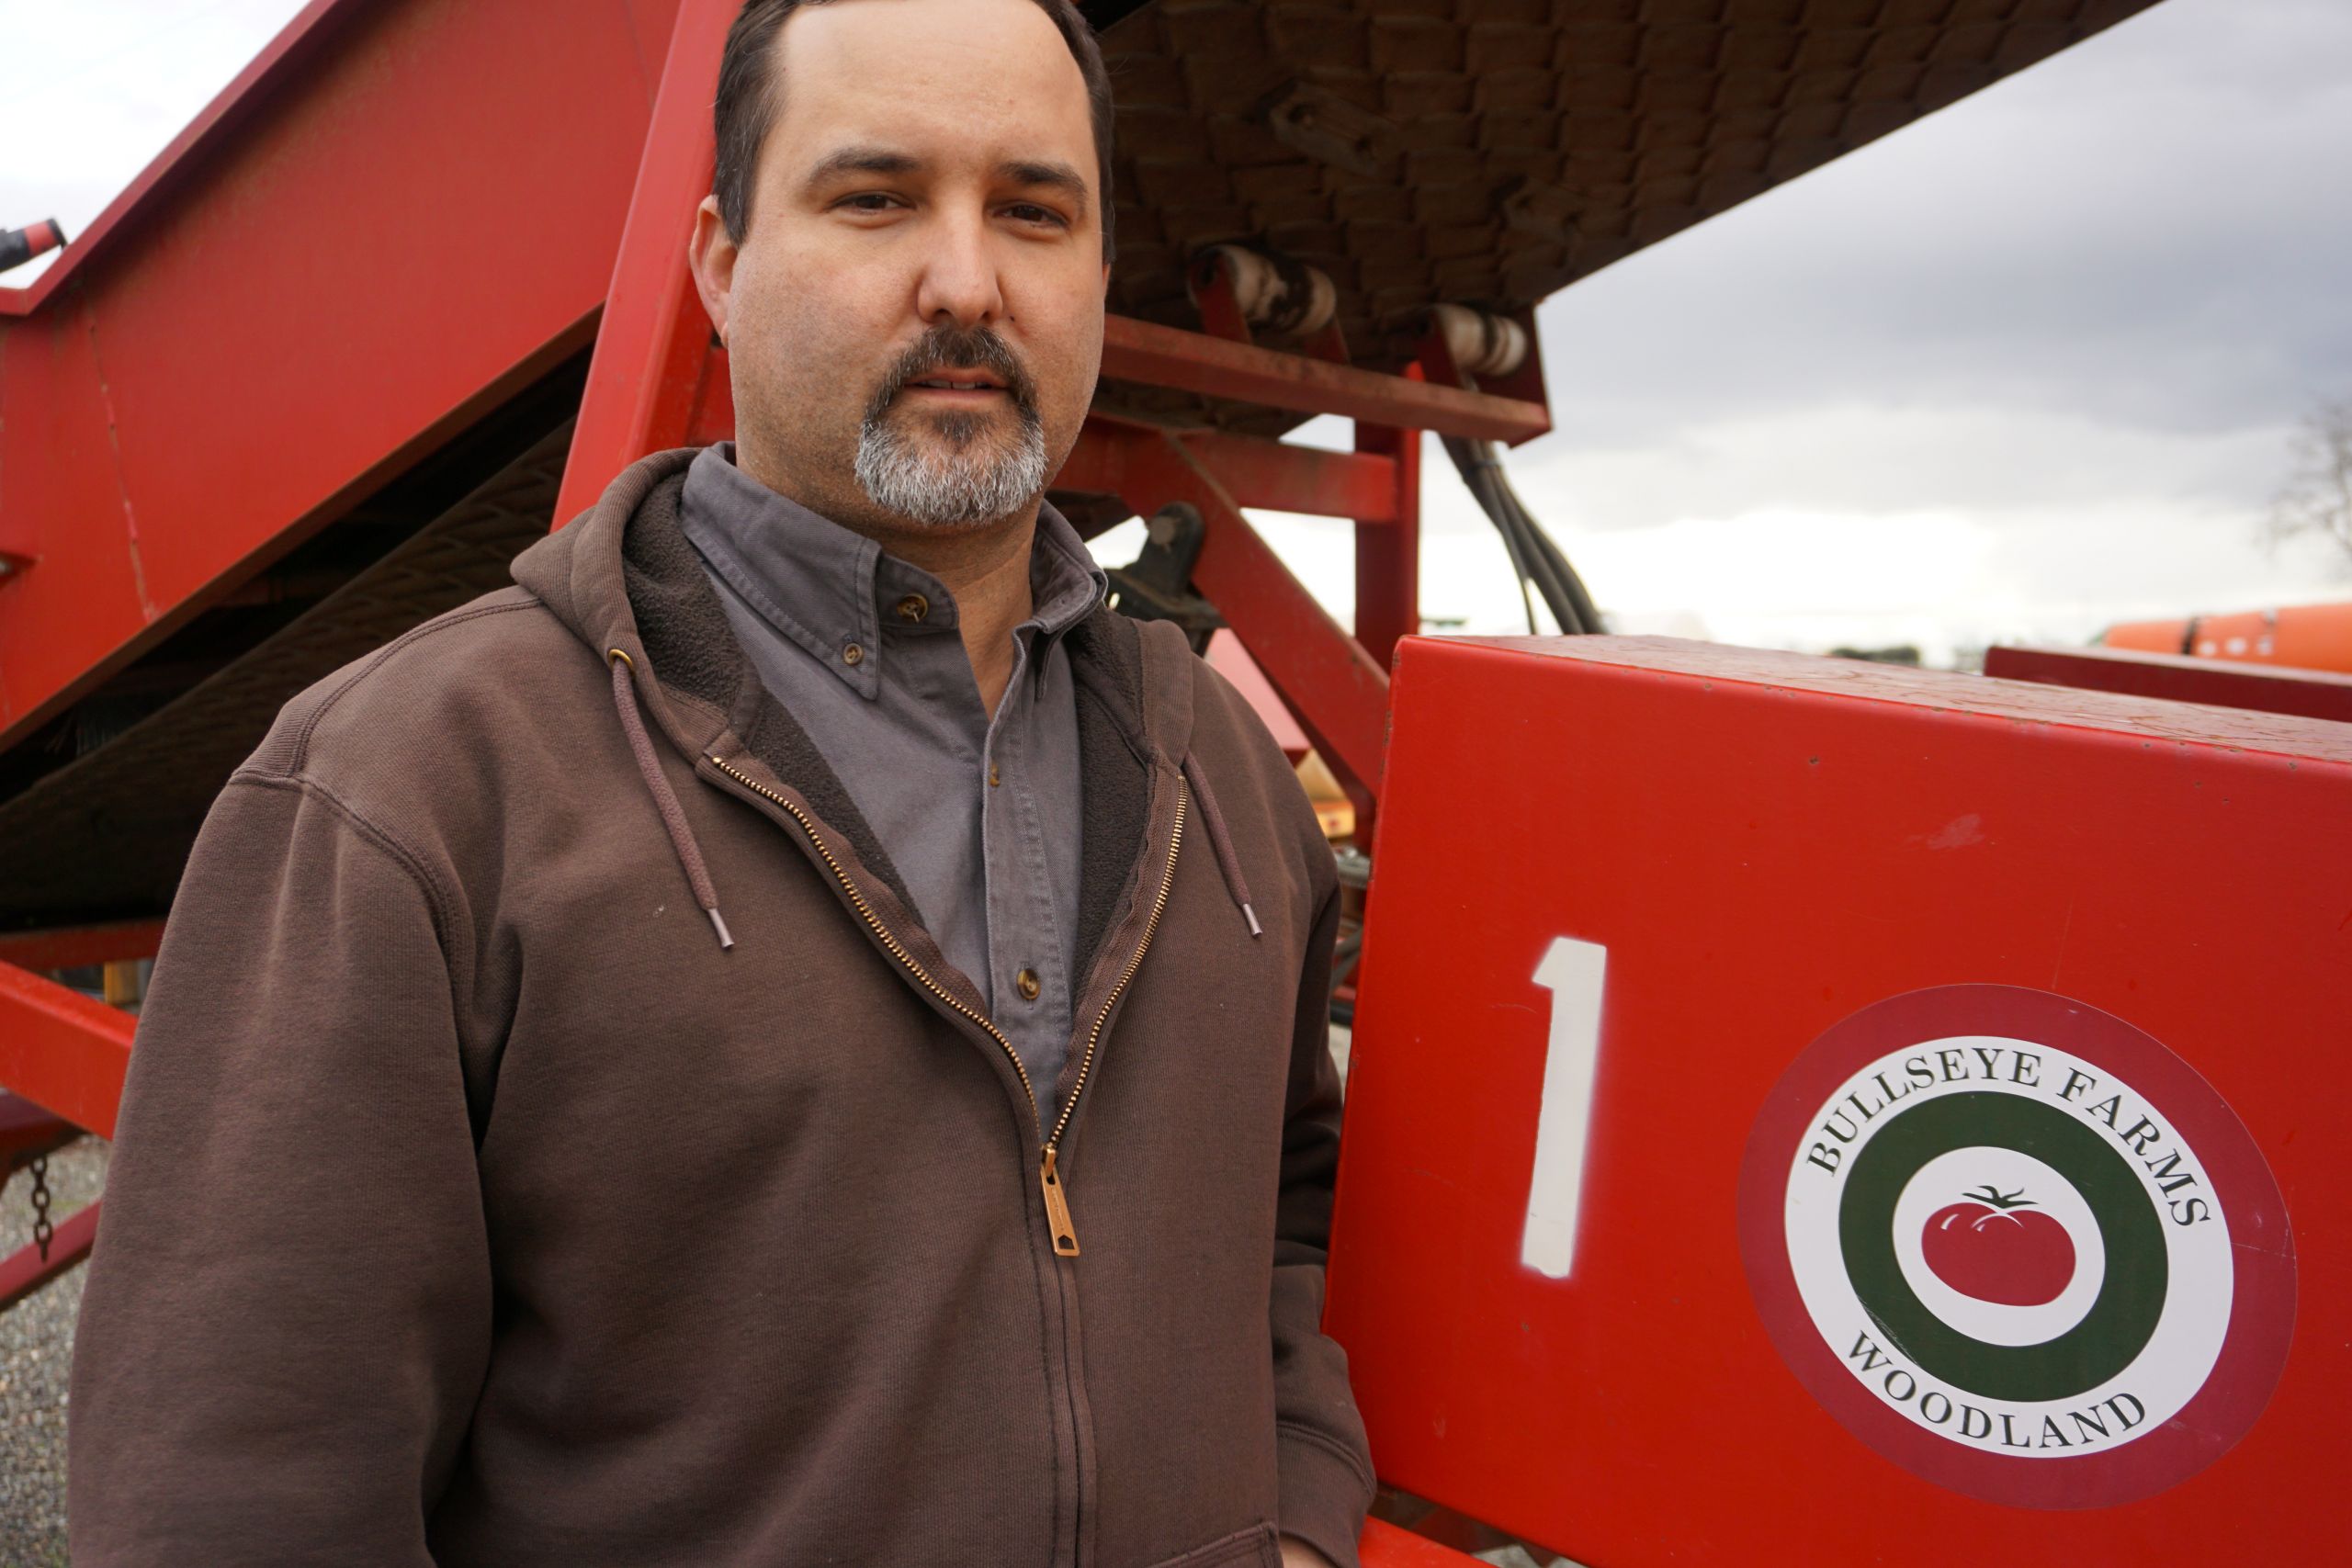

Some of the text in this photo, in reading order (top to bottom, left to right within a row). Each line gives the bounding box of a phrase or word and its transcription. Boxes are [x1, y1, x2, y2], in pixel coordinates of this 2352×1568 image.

[1521, 938, 1607, 1279] 1
[1806, 1047, 2211, 1227] BULLSEYE FARMS
[1848, 1330, 2146, 1449] WOODLAND
